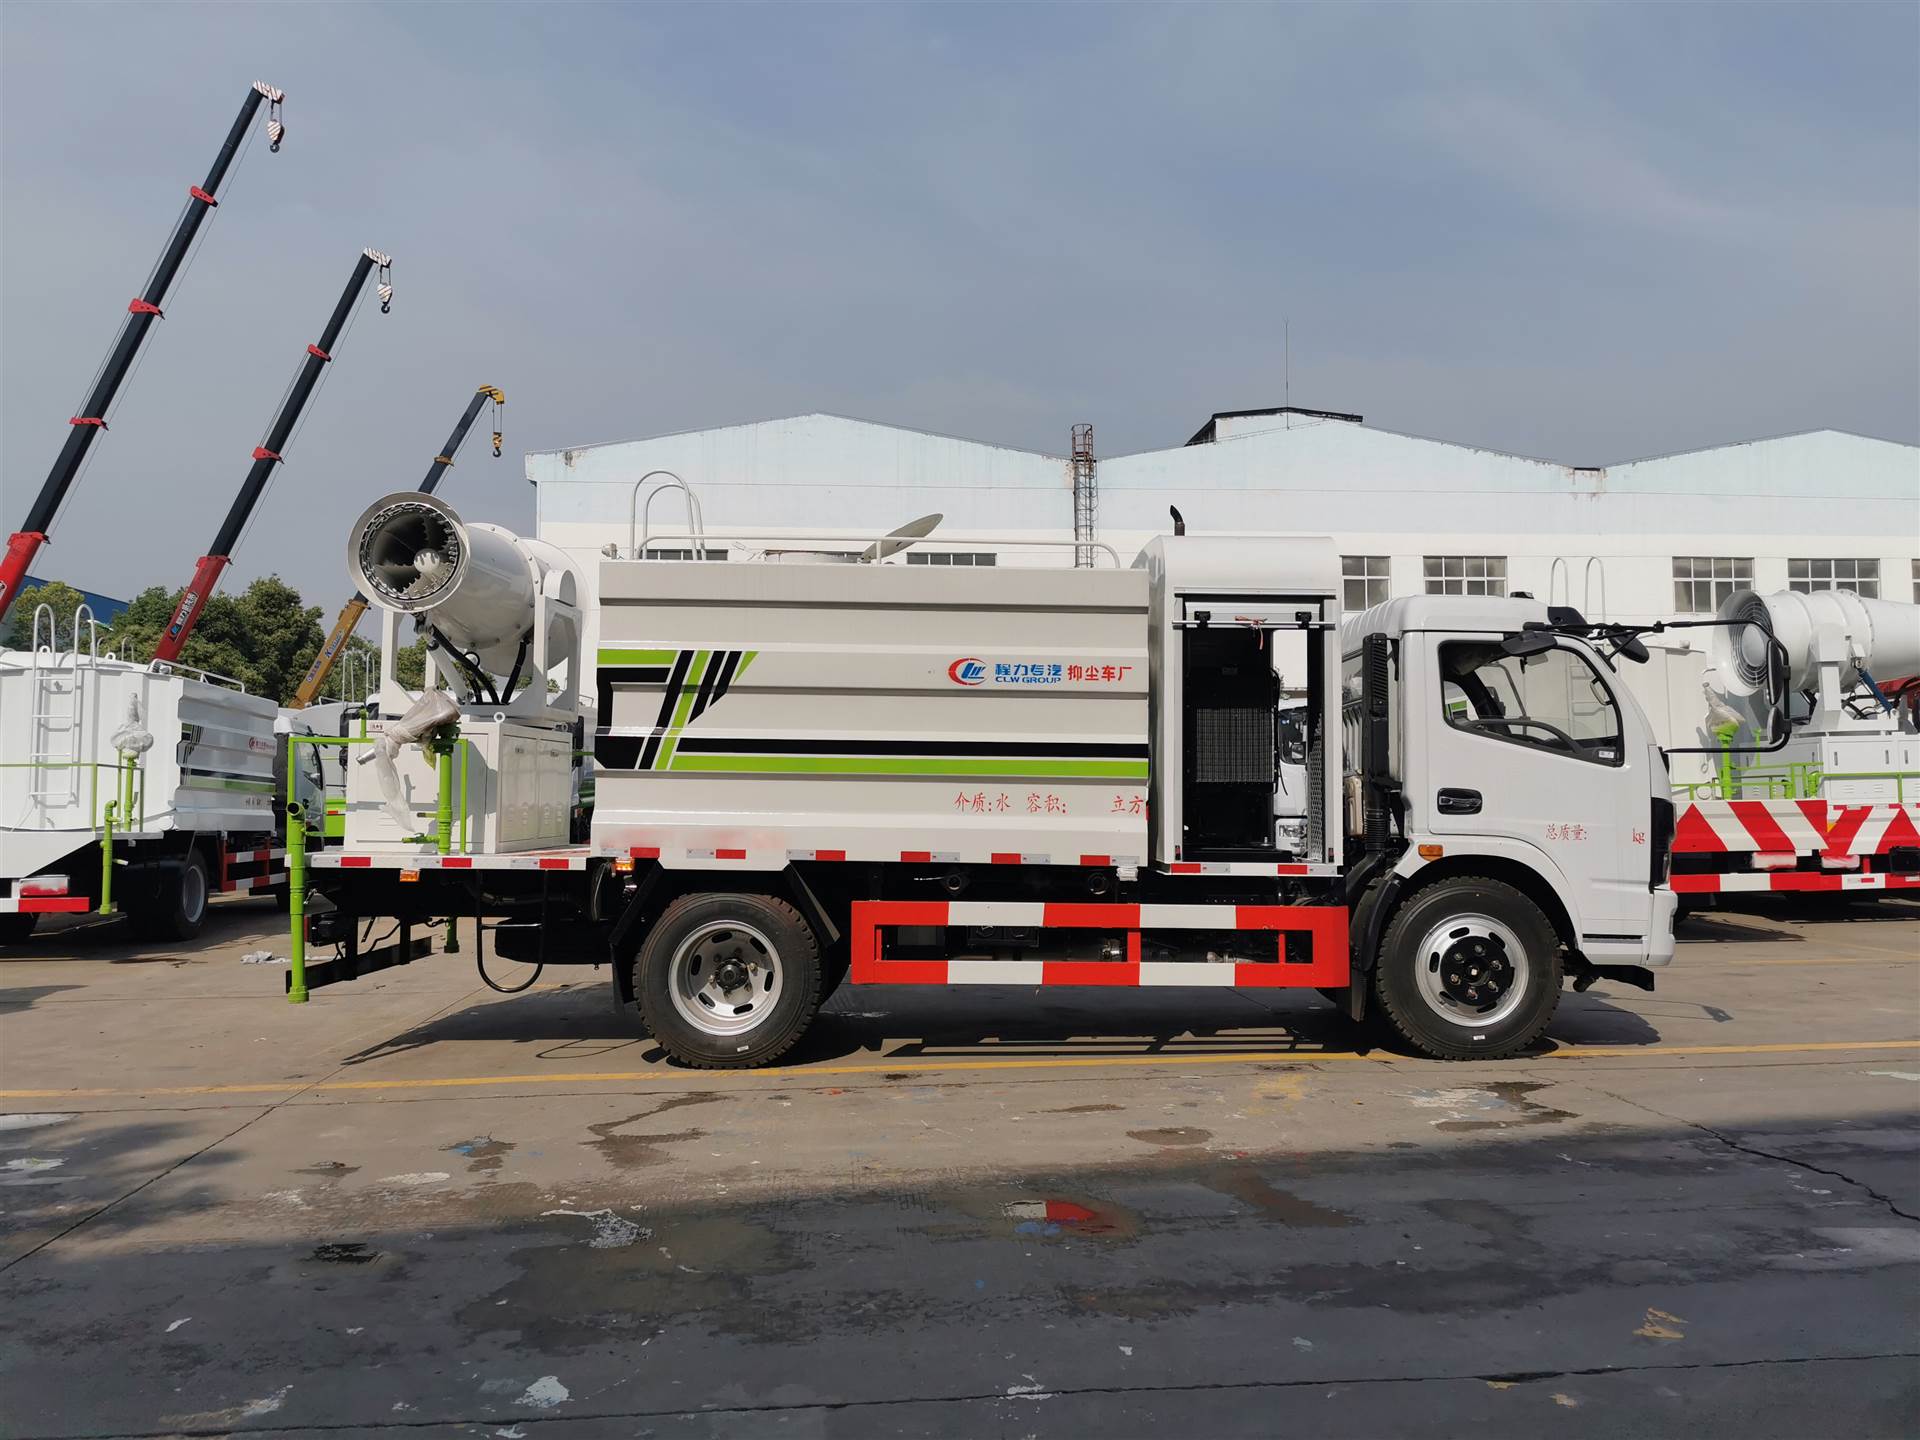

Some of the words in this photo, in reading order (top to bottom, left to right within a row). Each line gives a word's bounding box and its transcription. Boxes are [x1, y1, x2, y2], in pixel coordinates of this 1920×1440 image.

[995, 664, 1062, 676] 程力专汽
[1067, 665, 1132, 682] 抑尘车厂
[1111, 795, 1144, 814] 立方
